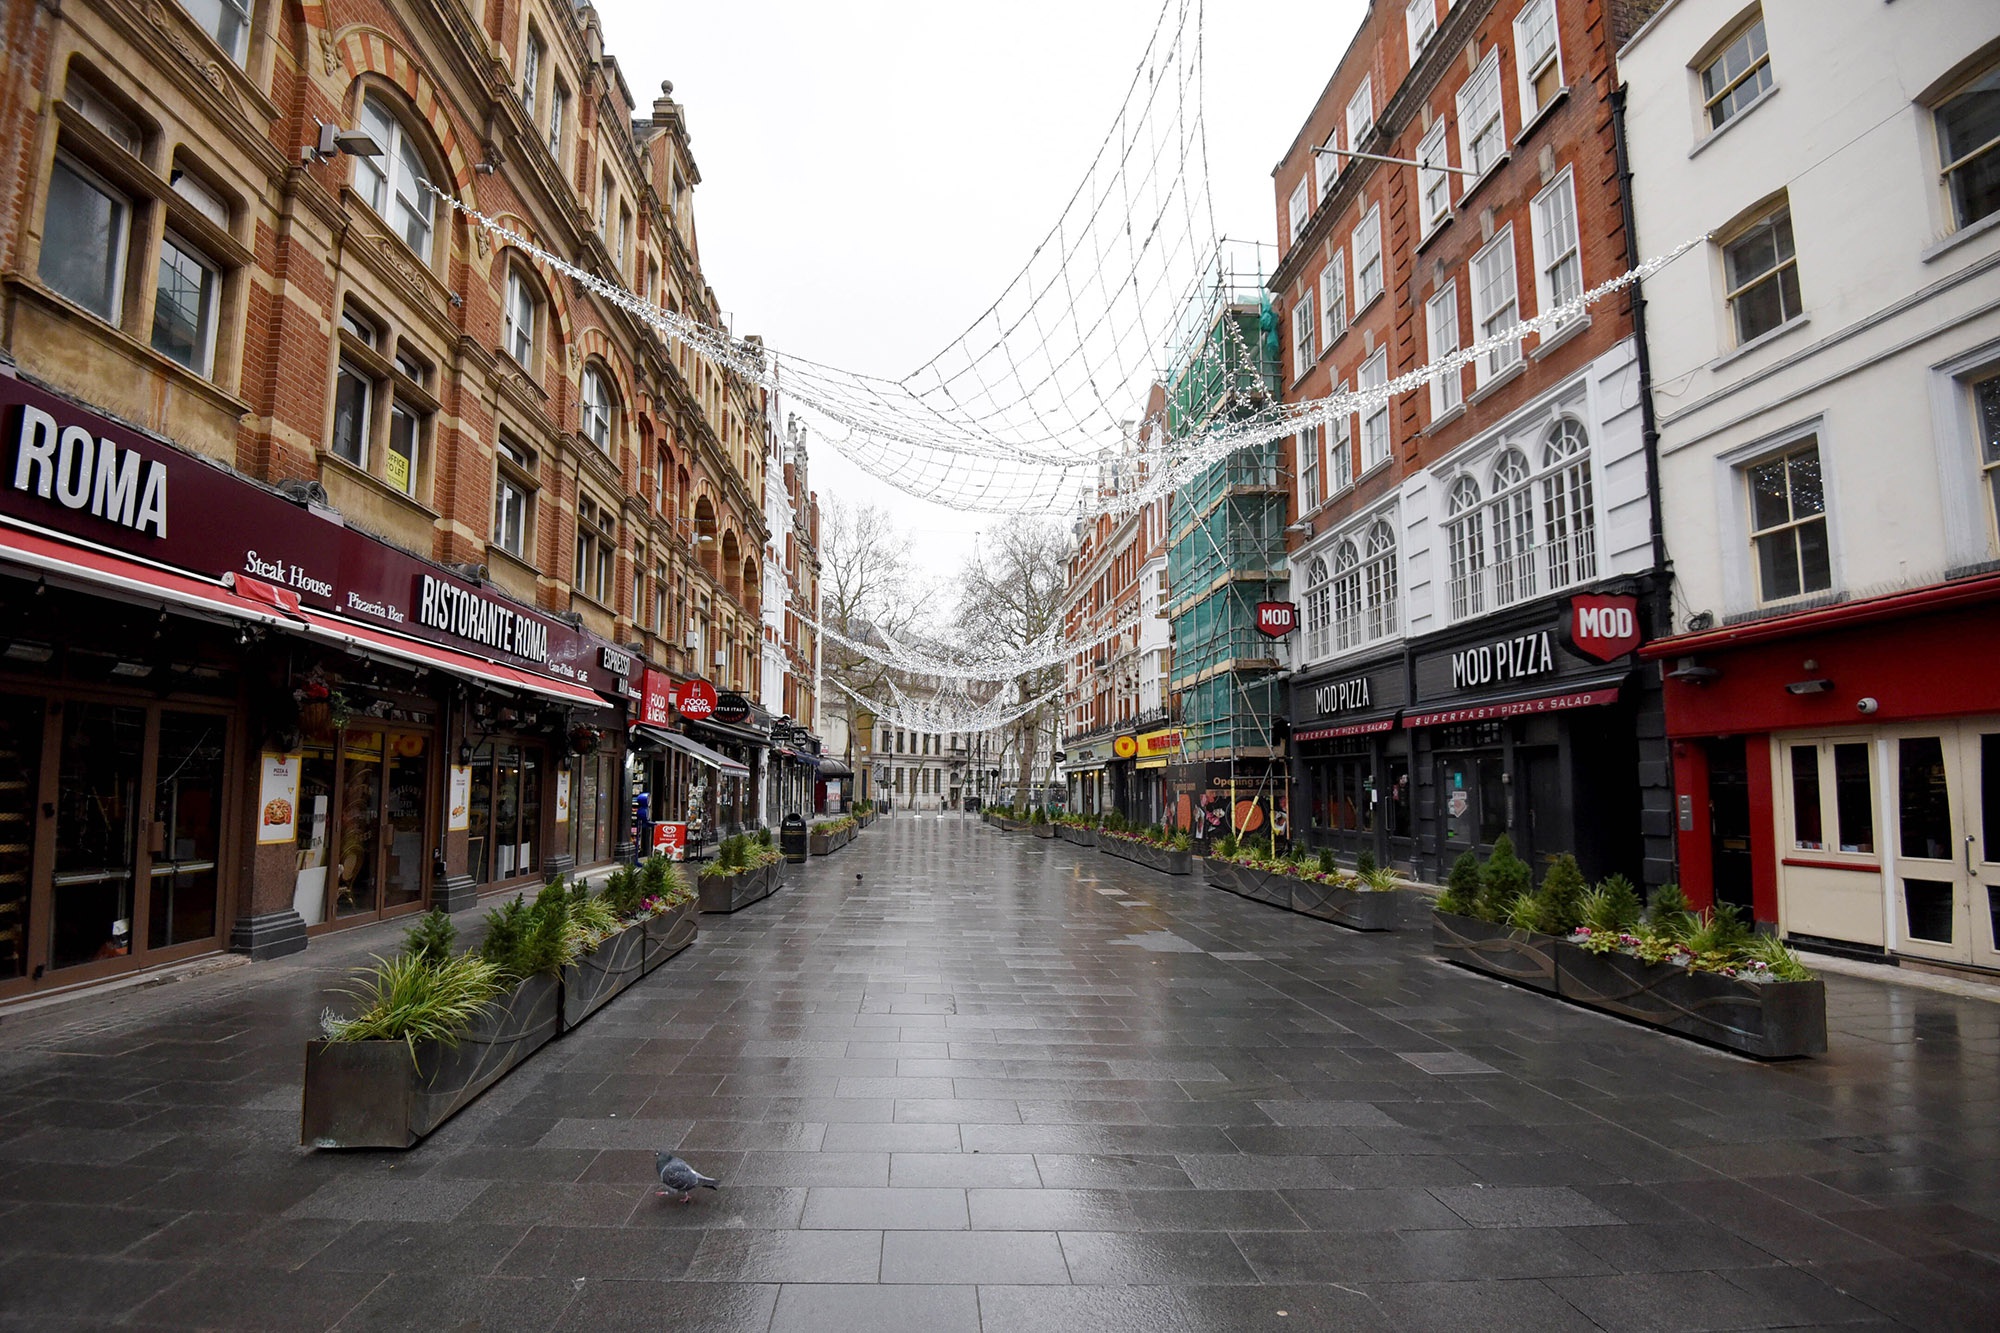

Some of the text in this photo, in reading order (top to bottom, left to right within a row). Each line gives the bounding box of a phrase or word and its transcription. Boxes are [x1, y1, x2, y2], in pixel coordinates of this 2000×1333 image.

[14, 404, 167, 539] ROMA
[244, 550, 332, 597] Steak House
[347, 592, 404, 623] Pizzeria Bar
[421, 574, 547, 663] RISTORANTE ROMA
[1262, 609, 1291, 625] MOD
[1579, 607, 1633, 638] MOD
[603, 647, 631, 676] ESPRESSO
[1453, 631, 1553, 688] MOD PIZZA
[651, 693, 665, 708] FOOD
[687, 705, 711, 713] NEWS
[1315, 678, 1369, 714] MOD PIZZA
[1415, 695, 1592, 726] SUPERFAST PIZZA & SALAD
[651, 709, 666, 723] NEWS
[1296, 728, 1340, 741] SUPERFAST
[1342, 726, 1359, 734] PIZZA
[1367, 722, 1388, 731] SALAD
[1213, 777, 1253, 787] Opening
